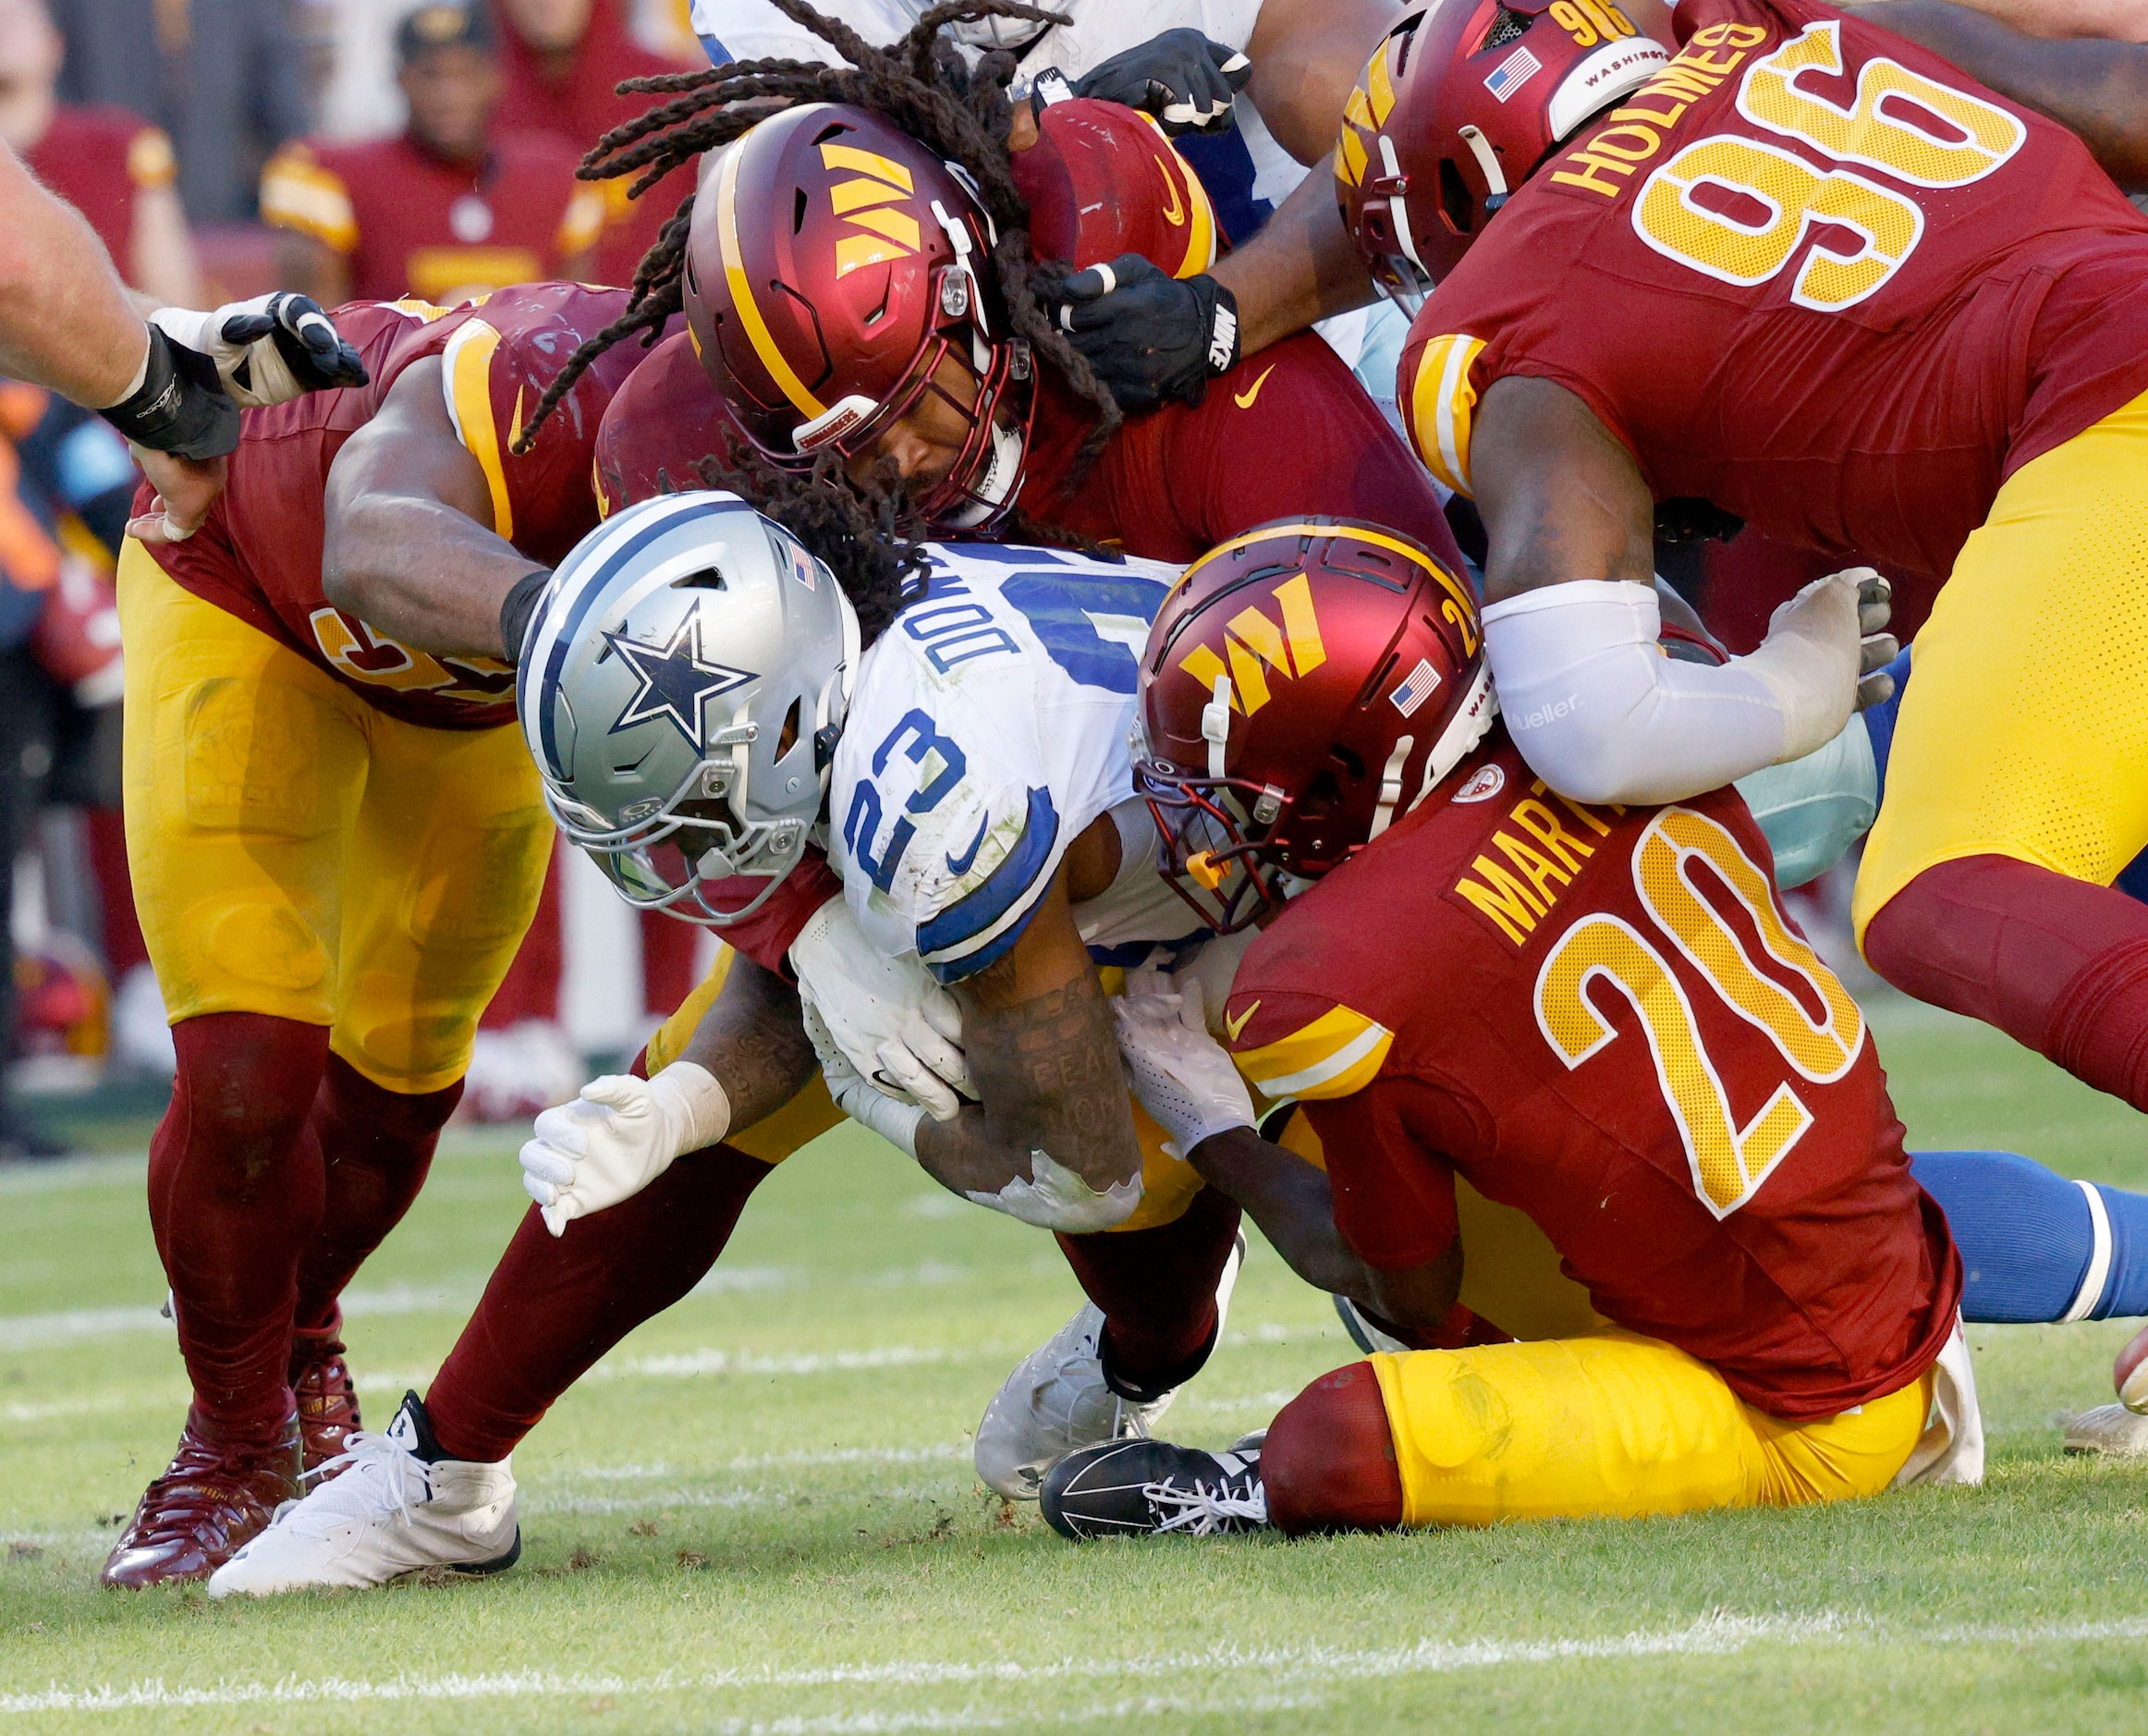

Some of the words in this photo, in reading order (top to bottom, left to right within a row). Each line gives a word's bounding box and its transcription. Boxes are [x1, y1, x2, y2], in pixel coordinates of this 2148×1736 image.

[1550, 23, 1767, 198] HOLMES
[1585, 50, 1671, 87] WASHINGTO
[1631, 19, 2027, 313] 96
[1208, 302, 1237, 372] NIKE
[894, 555, 1021, 675] DOW
[1468, 671, 1494, 717] WASH
[844, 708, 966, 894] 23
[1454, 777, 1627, 947] MART
[1534, 805, 1865, 1222] 20
